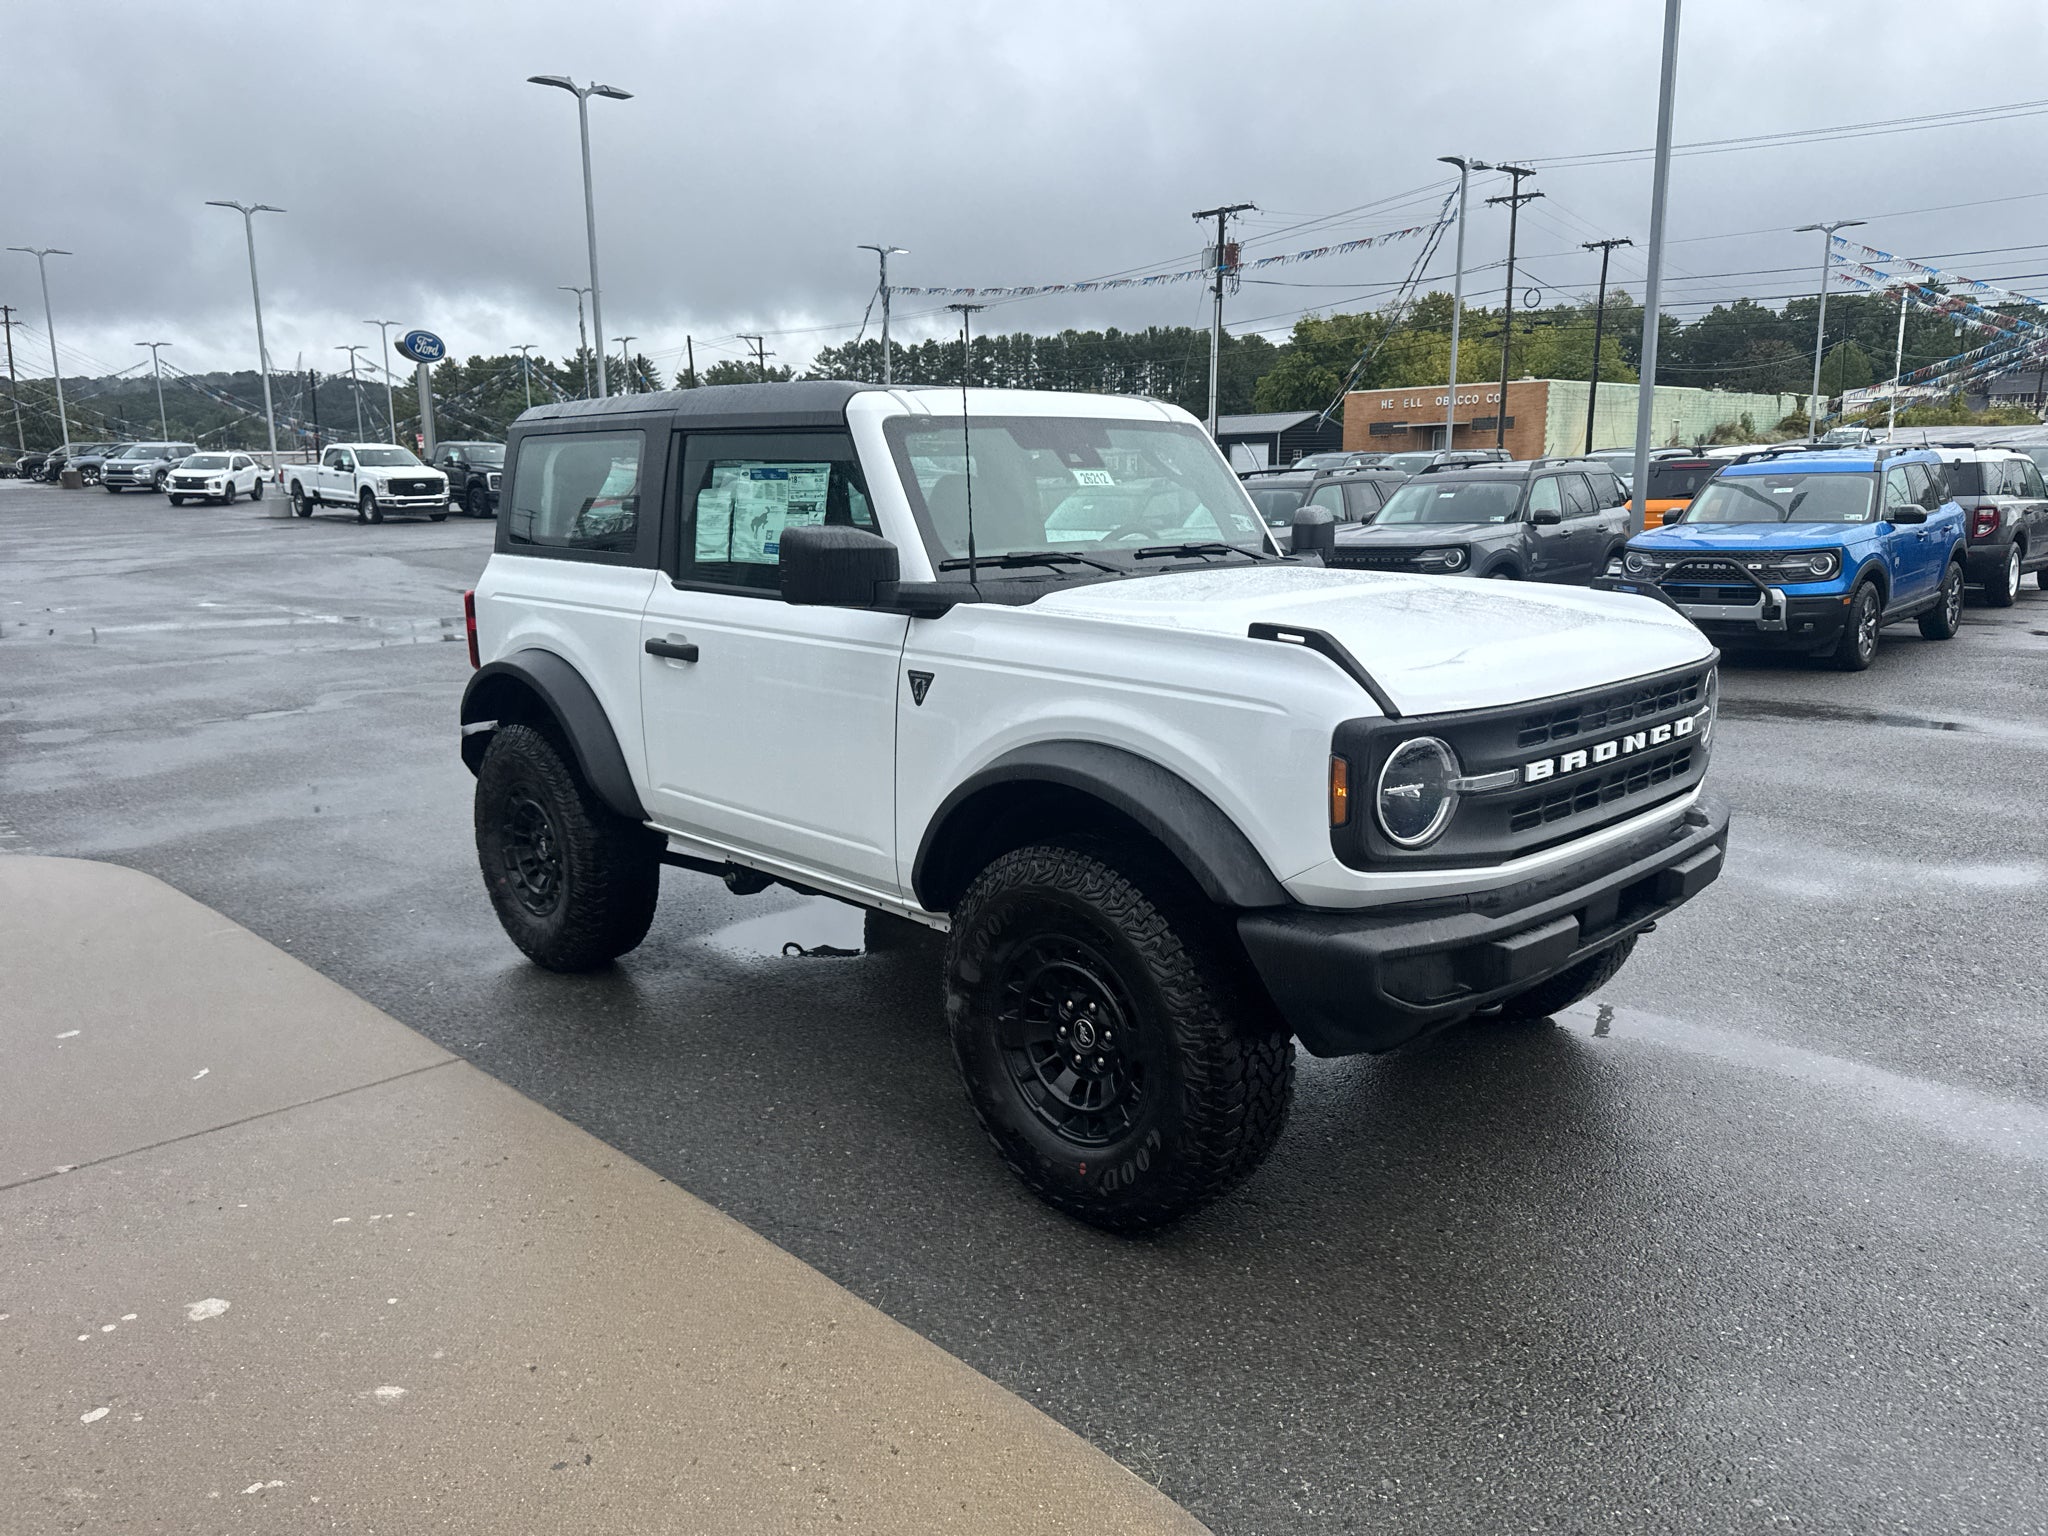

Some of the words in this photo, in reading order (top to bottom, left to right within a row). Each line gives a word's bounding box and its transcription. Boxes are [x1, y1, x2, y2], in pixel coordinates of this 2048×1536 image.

[415, 335, 440, 357] Ford
[1080, 472, 1109, 484] 26212
[1525, 716, 1694, 783] BRONCO
